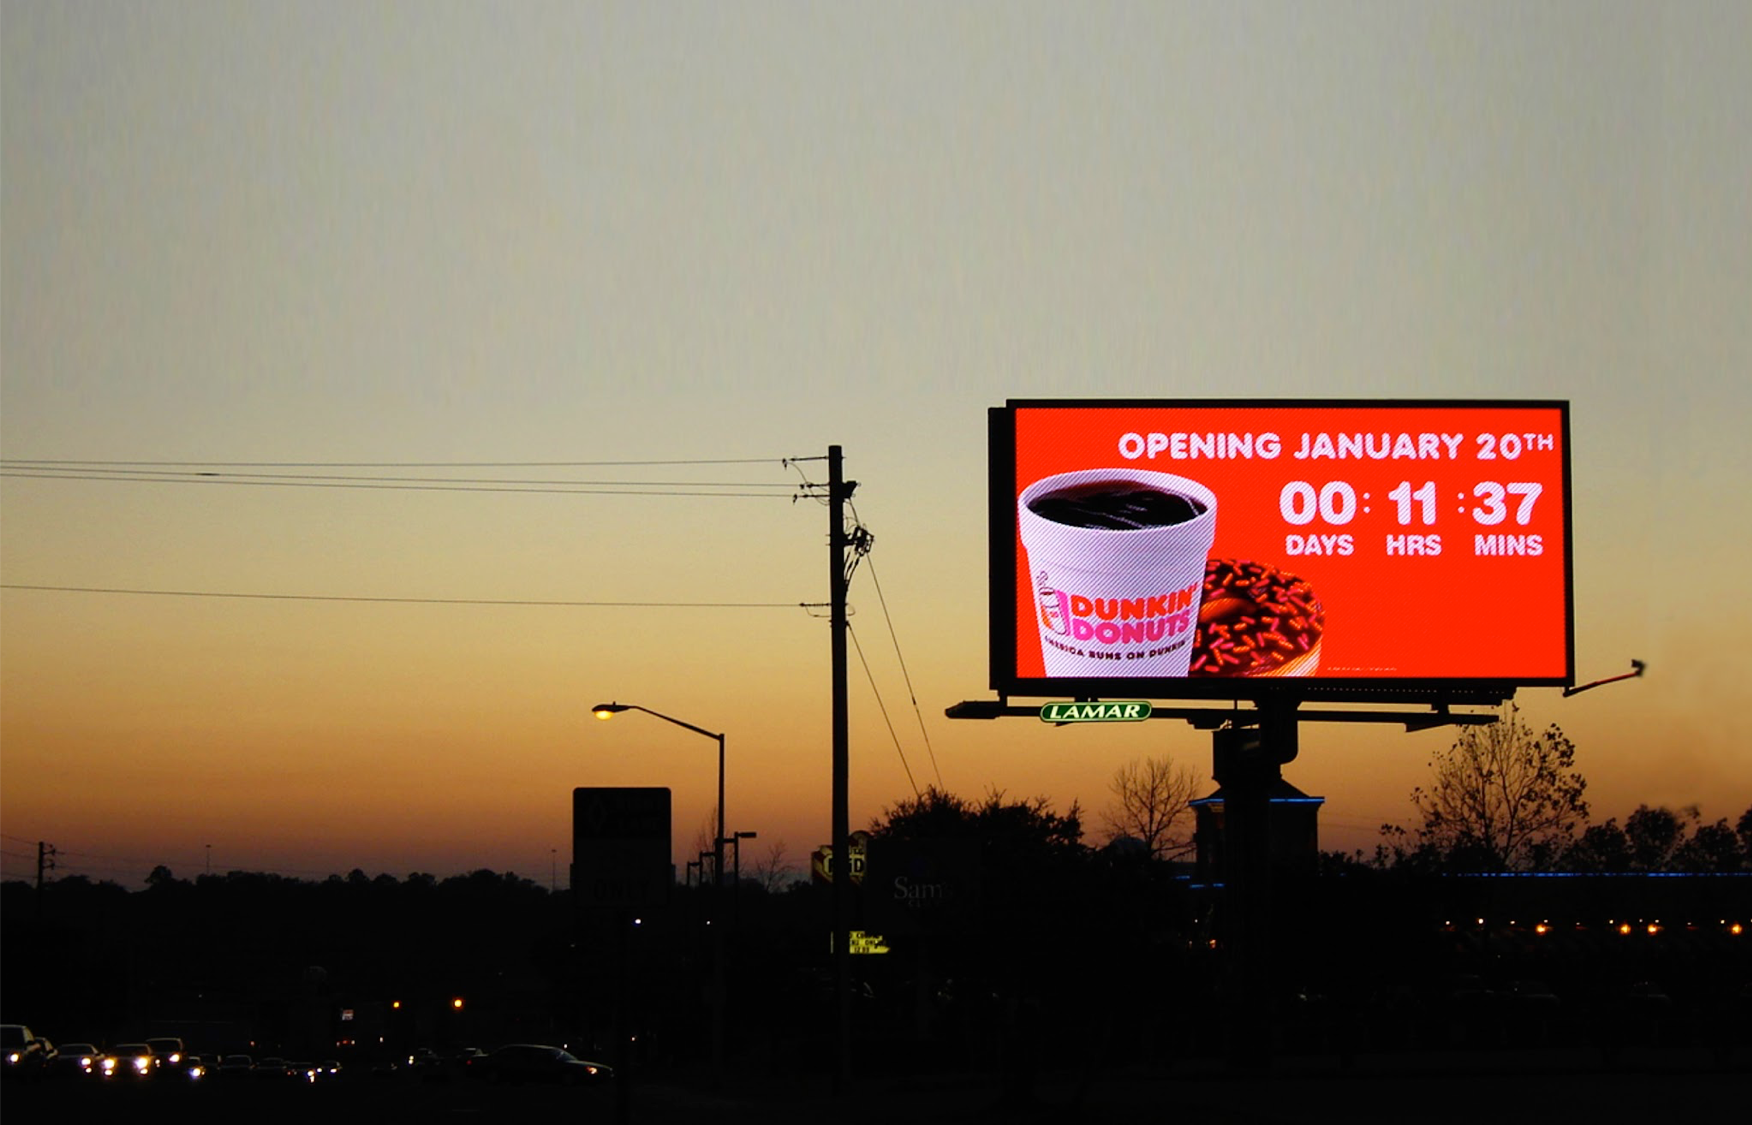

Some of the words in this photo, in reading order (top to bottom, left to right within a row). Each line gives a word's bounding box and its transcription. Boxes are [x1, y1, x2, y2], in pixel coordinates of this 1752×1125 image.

[1118, 432, 1282, 459] OPENING
[1293, 432, 1464, 460] JANUARY
[1476, 432, 1554, 460] 20TH
[1388, 480, 1437, 526] 11
[1285, 534, 1355, 557] DAYS
[1386, 534, 1443, 557] HRS
[1474, 534, 1544, 557] MINS
[1072, 608, 1191, 645] DONUTS
[1088, 650, 1122, 661] RUNS
[1126, 650, 1145, 661] ON
[1049, 704, 1141, 719] LAMAR
